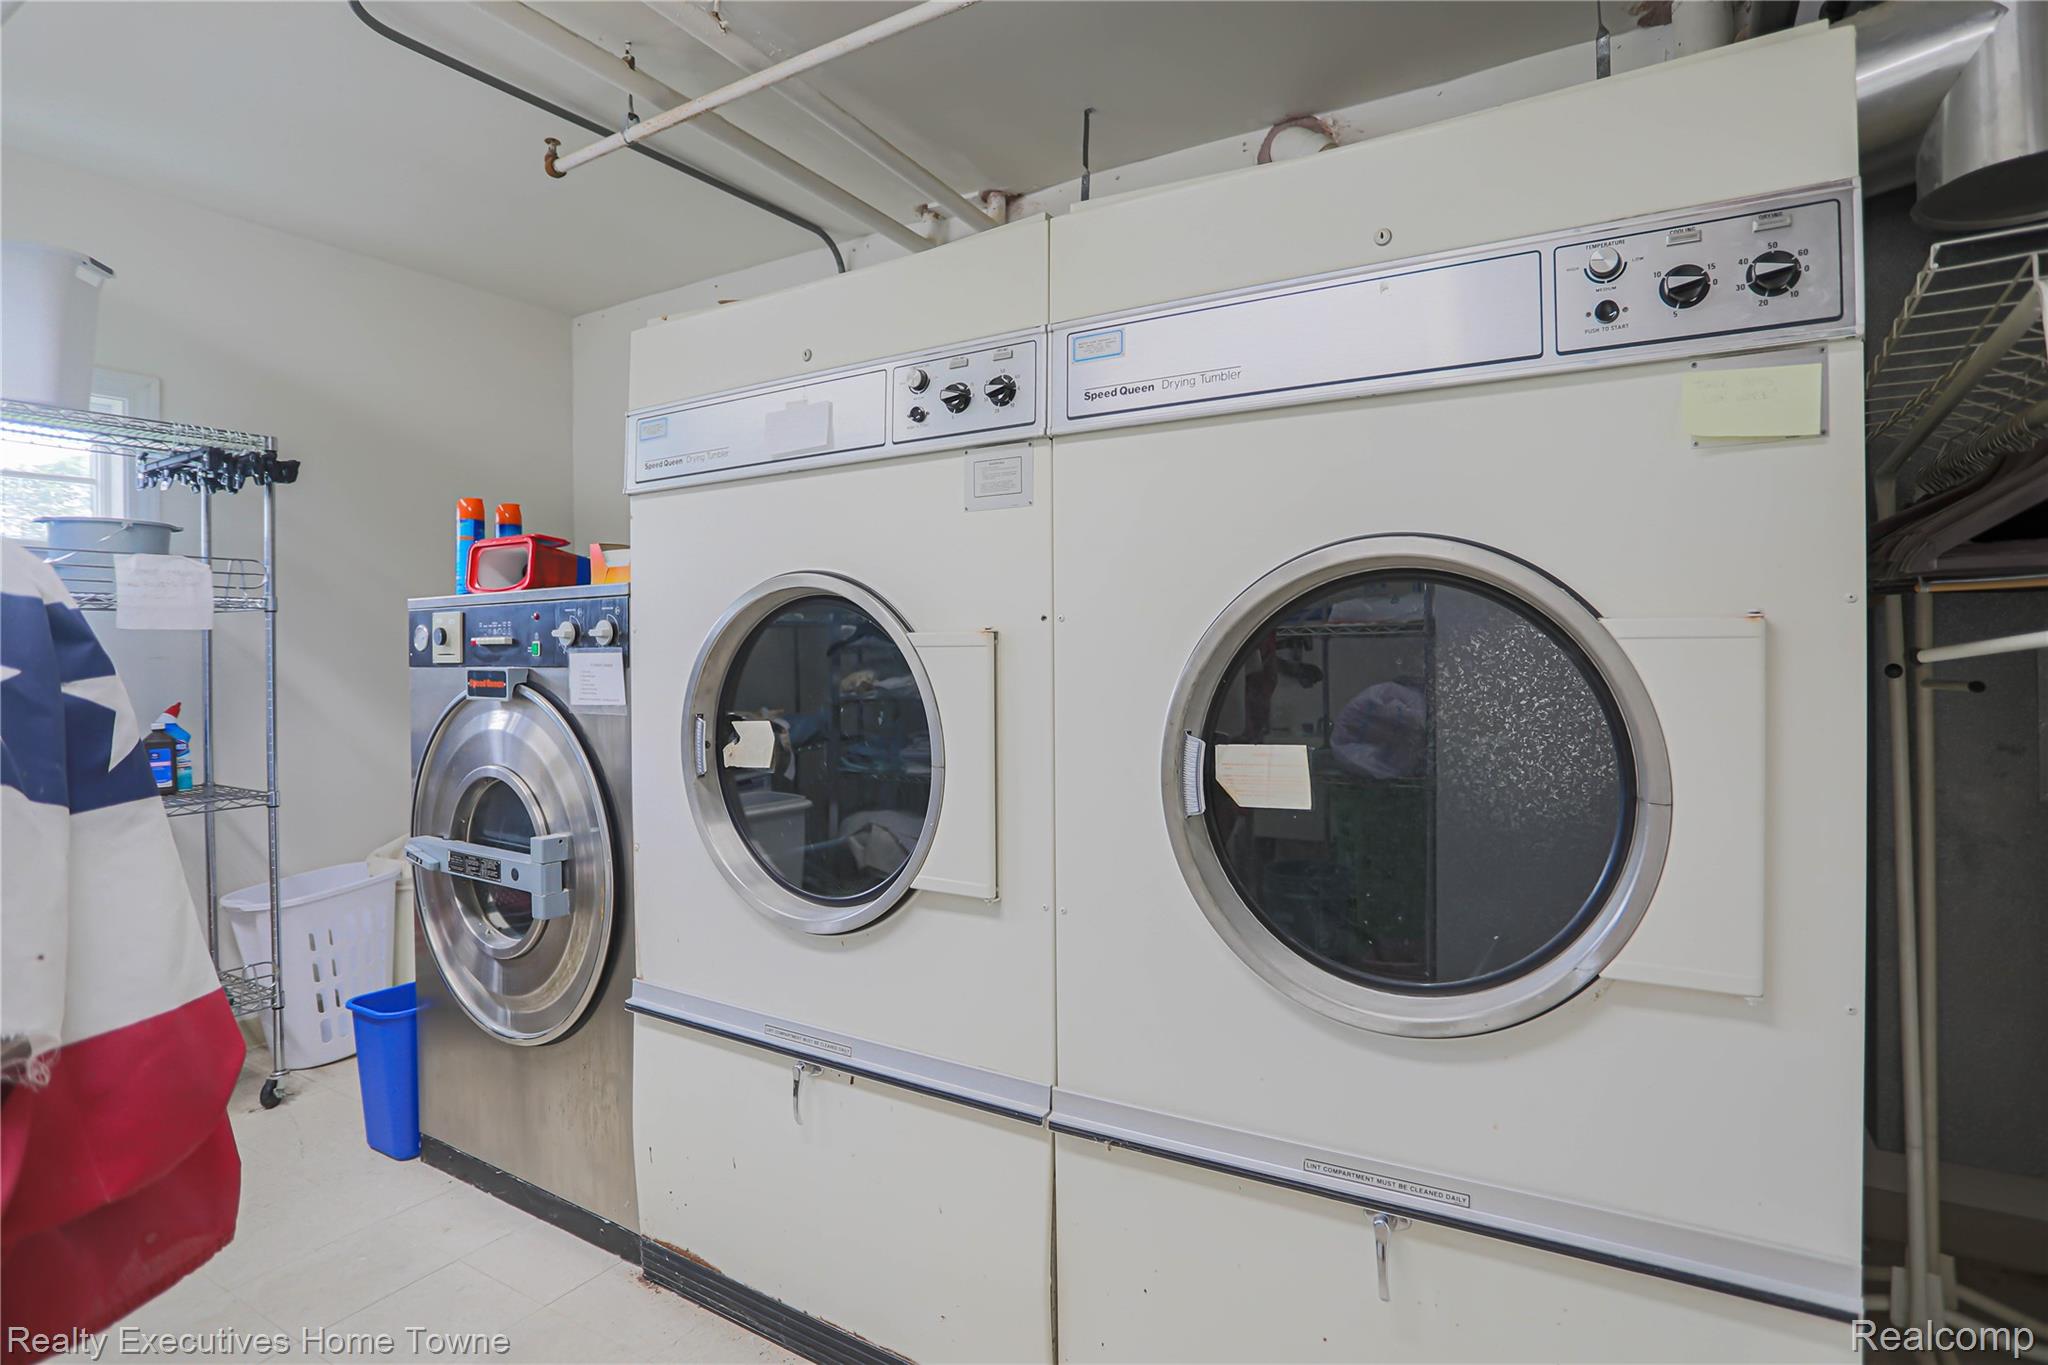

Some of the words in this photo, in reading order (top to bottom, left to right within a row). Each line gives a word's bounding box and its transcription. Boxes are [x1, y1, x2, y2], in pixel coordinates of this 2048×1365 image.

[1585, 239, 1626, 250] TEMPERATURE
[1767, 241, 1778, 249] 50
[1798, 248, 1809, 256] 60
[1707, 262, 1716, 271] 15
[1653, 271, 1662, 279] 10
[1712, 278, 1719, 286] 0
[1735, 284, 1746, 292] 30
[1790, 290, 1799, 298] 10
[1758, 299, 1769, 307] 20
[1584, 326, 1600, 335] PUSH
[1602, 324, 1610, 332] TO
[1611, 322, 1630, 331] START
[1084, 387, 1118, 402] Speed
[1119, 383, 1155, 396] Queen
[1161, 376, 1196, 390] Drying
[1200, 369, 1242, 384] Tumbler
[644, 460, 664, 471] Speed
[664, 457, 684, 468] Queen
[1306, 1162, 1322, 1171] LINT
[1322, 1165, 1376, 1183] COMPARTMENT
[1376, 1178, 1398, 1188] MUST
[1398, 1183, 1409, 1191] BE
[1409, 1185, 1445, 1199] CLEANED
[1445, 1193, 1468, 1204] DAILY
